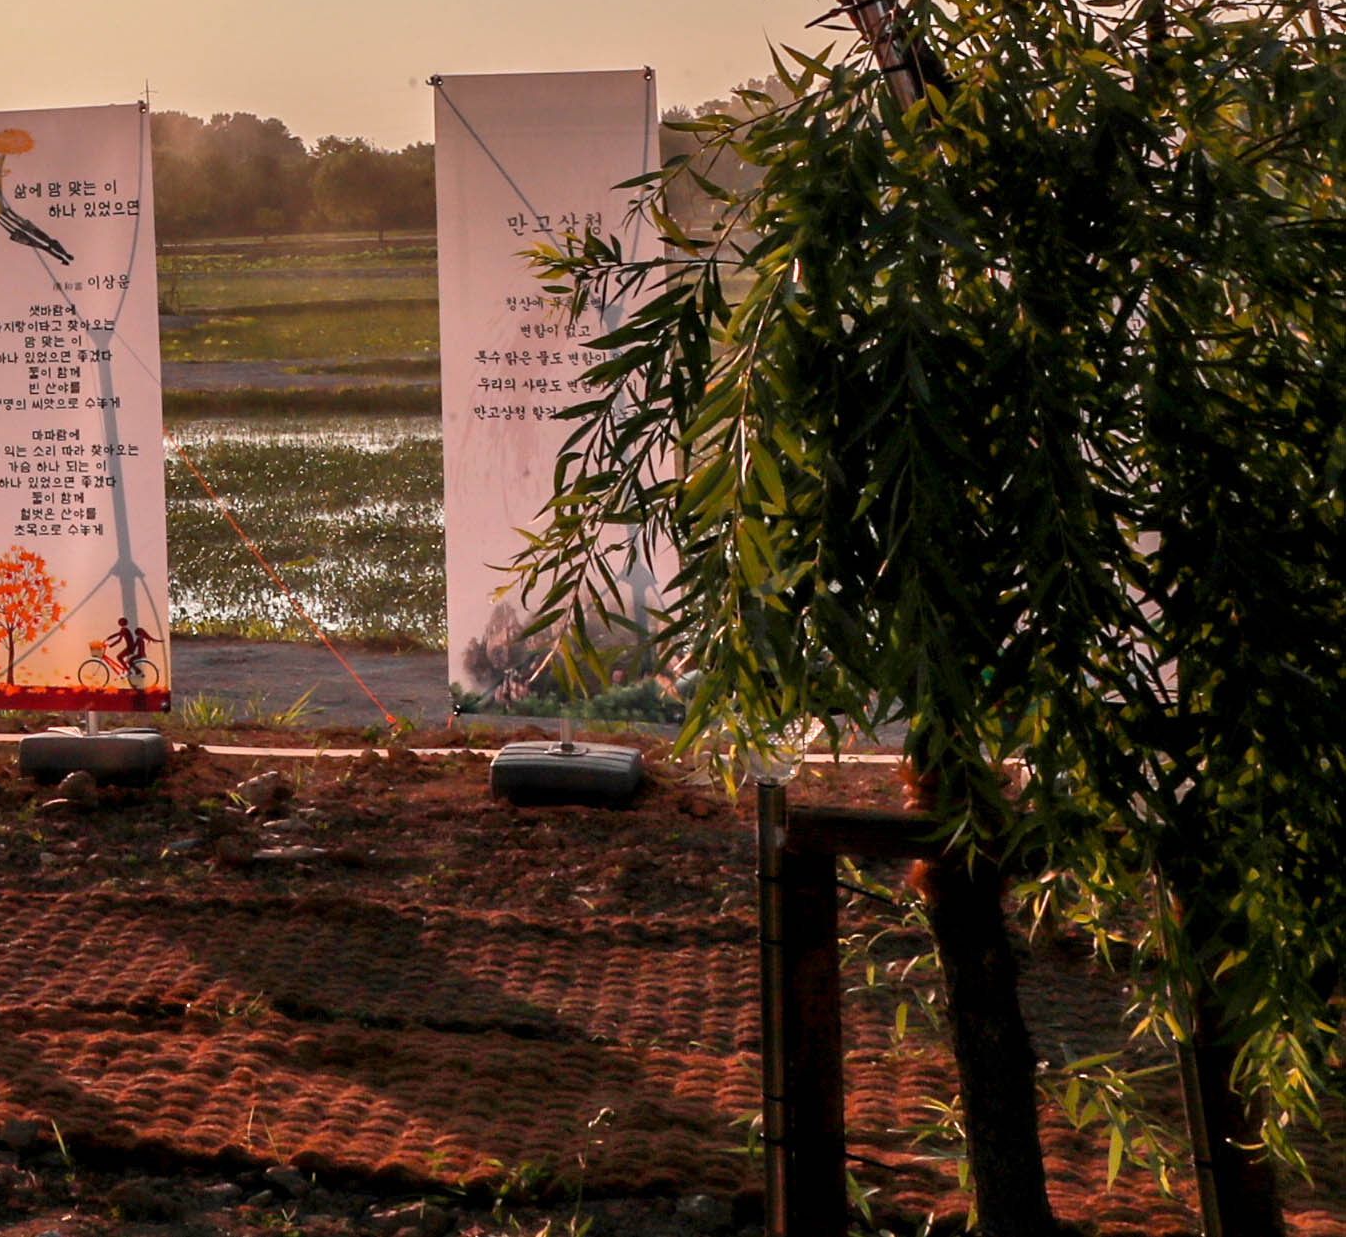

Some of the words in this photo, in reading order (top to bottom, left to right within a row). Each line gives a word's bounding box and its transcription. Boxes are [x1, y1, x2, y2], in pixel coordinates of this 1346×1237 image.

[14, 183, 42, 199] 삶에
[48, 182, 61, 197] 맘
[68, 181, 96, 196] 맞는
[104, 179, 116, 194] 이
[49, 203, 76, 218] 하나
[84, 200, 139, 218] 있었으면
[508, 212, 602, 236] 만고상청
[87, 274, 130, 289] 이상운
[506, 296, 544, 311] 청산에
[68, 319, 115, 332] 찾아오는
[520, 324, 558, 338] 변함이
[564, 324, 591, 339] 없고
[24, 336, 36, 348] 맘
[42, 335, 65, 348] 맞는
[71, 335, 82, 346] 이
[25, 351, 71, 363] 있었으면
[78, 349, 112, 362] 좋겠다
[505, 351, 532, 365] 맑은
[536, 352, 563, 365] 물도
[567, 351, 606, 365] 변함이
[29, 366, 51, 379] 둘이
[58, 366, 80, 379] 함께
[29, 383, 40, 395] 빈
[45, 382, 80, 394] 산야를
[477, 378, 516, 392] 우리의
[522, 379, 562, 394] 사랑도
[32, 398, 79, 410] 씨앗으로
[85, 397, 120, 409] 수놓게
[474, 405, 525, 420] 만고상청
[32, 429, 80, 441] 마파람에
[4, 445, 27, 458] 익는
[33, 445, 56, 457] 소리
[62, 445, 84, 457] 따라
[91, 444, 139, 456] 찾아오는
[8, 461, 30, 473] 가슴
[37, 461, 60, 473] 하나
[66, 461, 89, 472] 되는
[96, 460, 107, 472] 이
[28, 476, 74, 489] 있었으면
[82, 475, 116, 488] 좋겠다
[32, 492, 55, 505] 둘이
[61, 492, 84, 504] 함께
[21, 508, 55, 521] 헐벗은
[61, 508, 96, 520] 산야를
[14, 524, 61, 536] 초목으로
[68, 524, 104, 536] 수놓게
